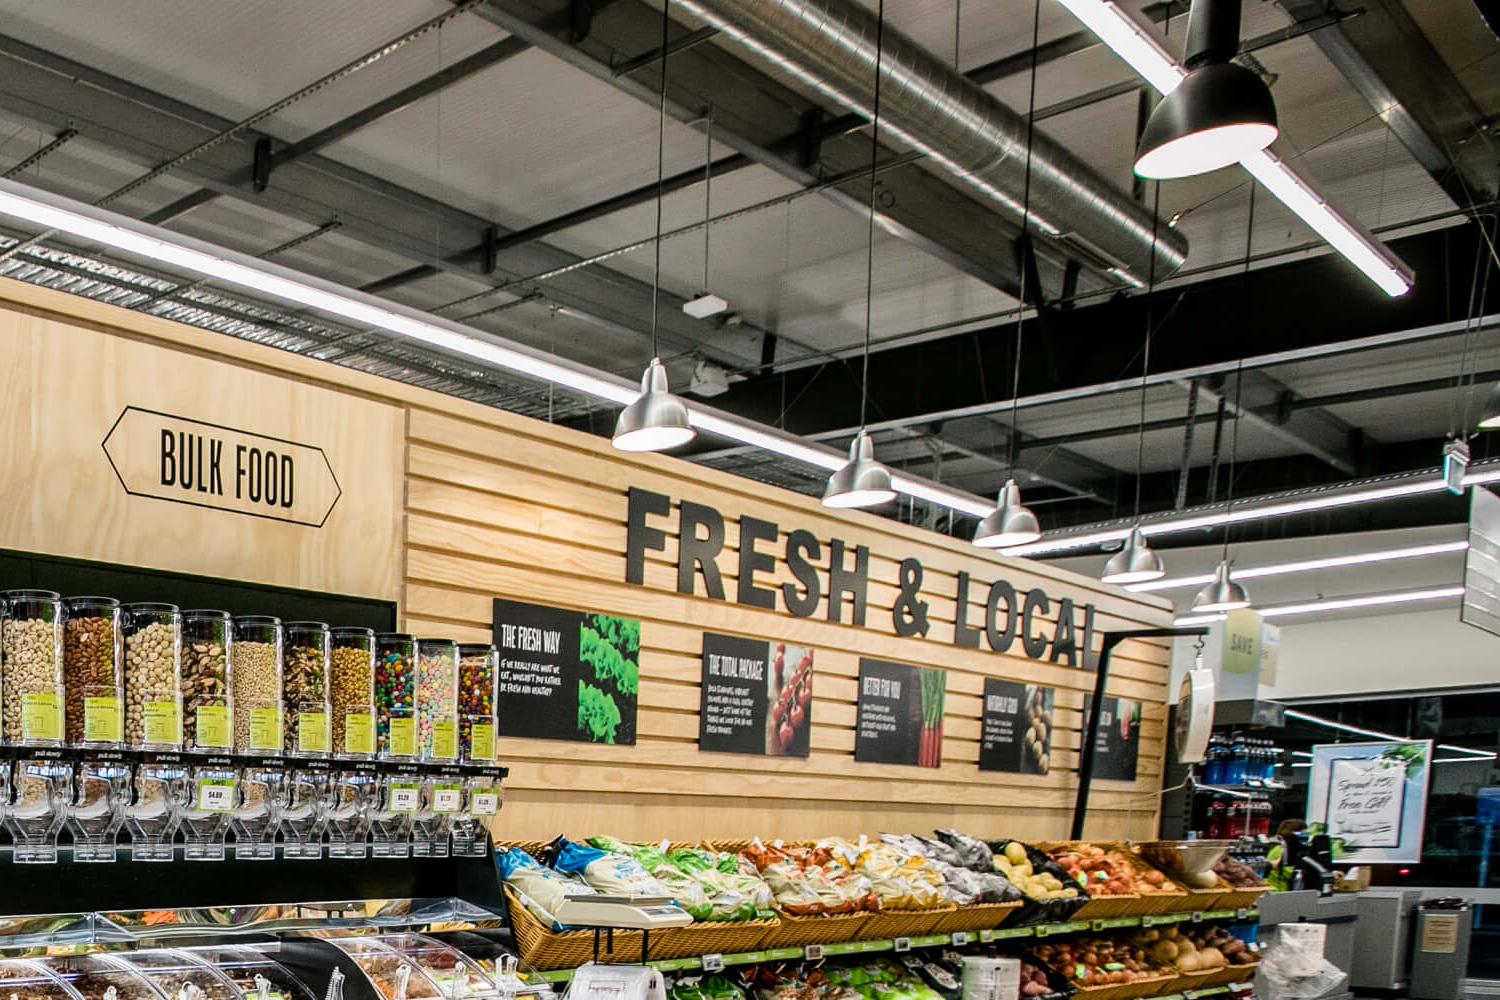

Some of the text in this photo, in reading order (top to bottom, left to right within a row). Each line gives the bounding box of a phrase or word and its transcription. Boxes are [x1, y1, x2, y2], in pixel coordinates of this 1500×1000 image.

[160, 428, 294, 508] BULK FOOD
[626, 486, 1097, 671] FRESH & LOCAL
[501, 624, 560, 654] THE FRESH WAY
[1232, 635, 1252, 654] SAVE
[739, 658, 763, 680] PACKAGE
